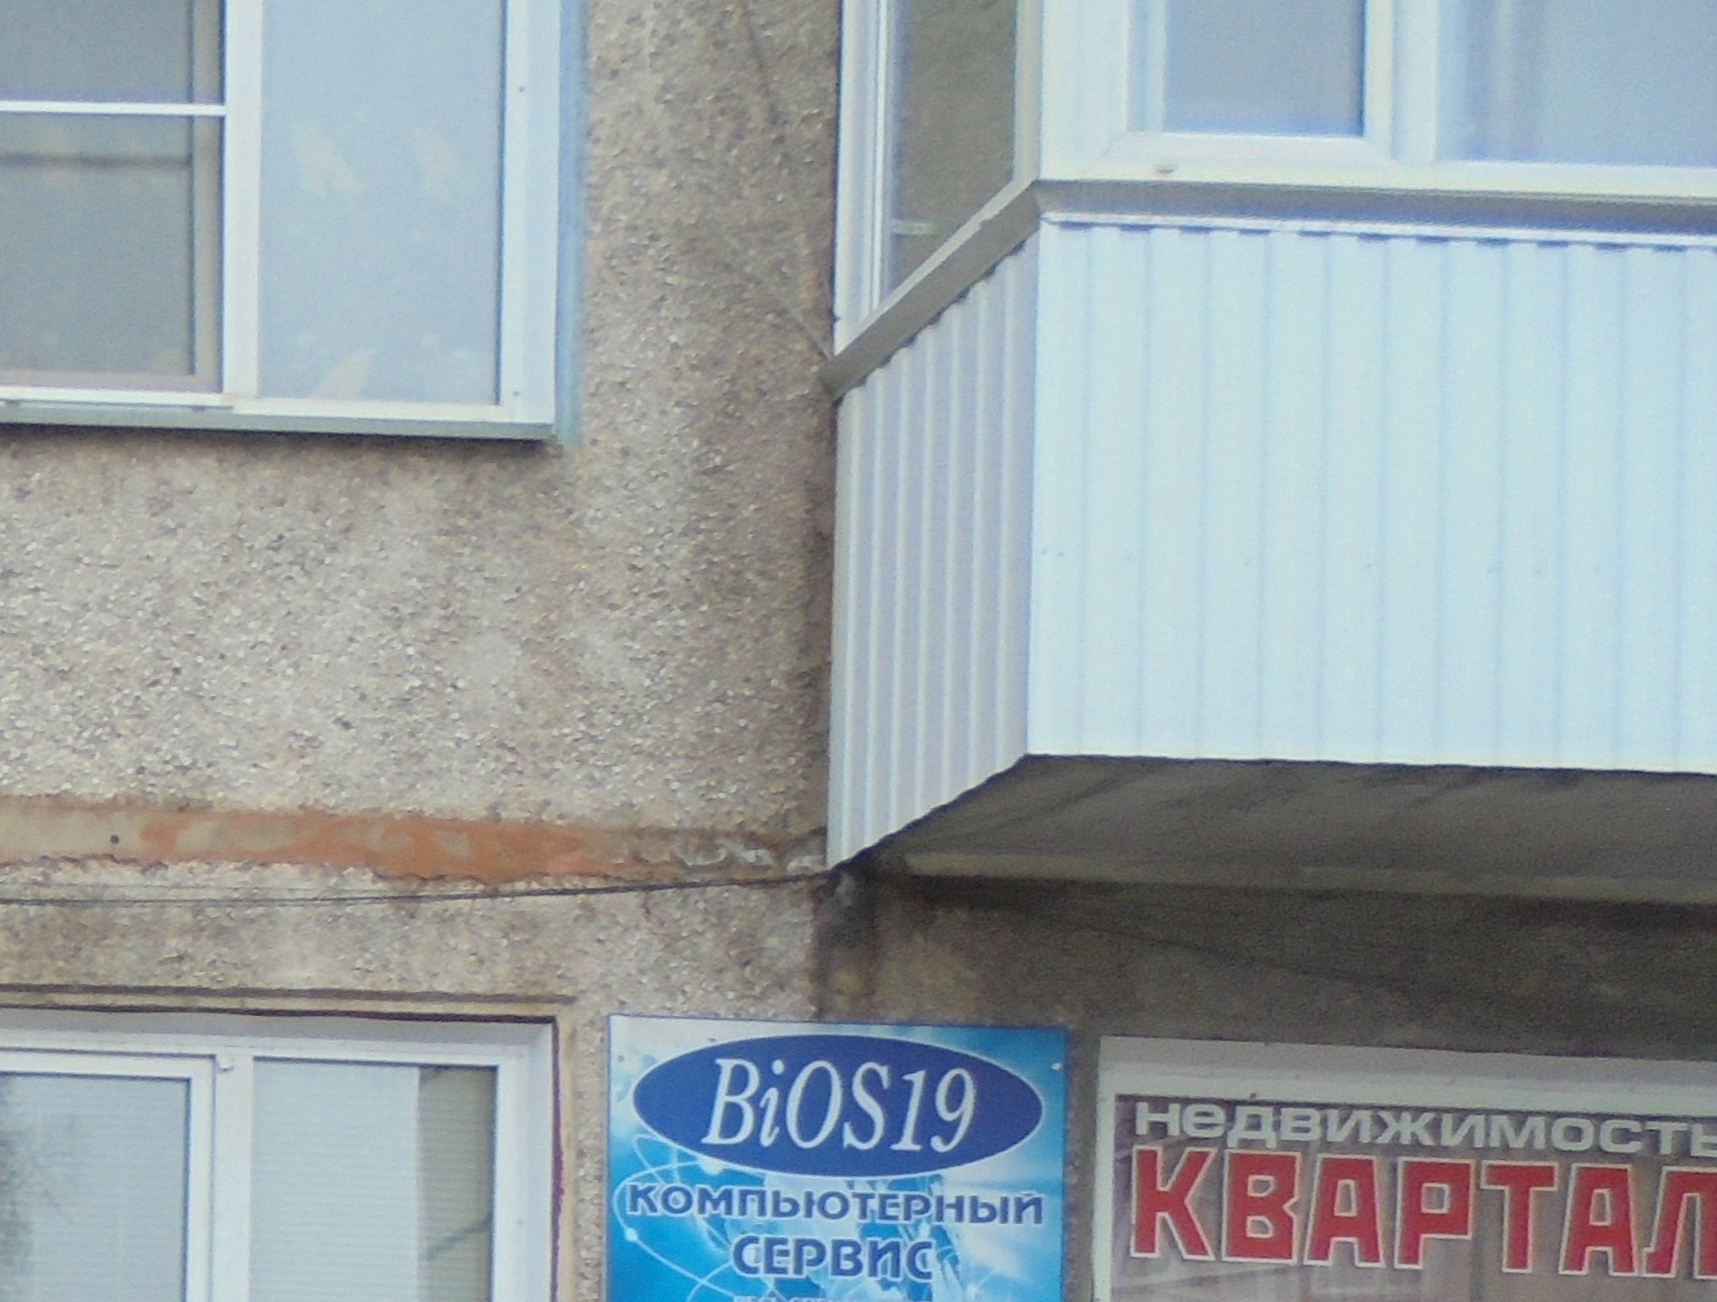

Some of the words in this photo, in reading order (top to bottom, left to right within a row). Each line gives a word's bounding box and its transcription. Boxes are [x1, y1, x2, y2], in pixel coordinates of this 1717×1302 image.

[701, 1057, 977, 1153] BiOS19
[627, 1184, 1043, 1225] КОМПЬЮТЕРНЫЙ
[1130, 1146, 1717, 1280] КВАРТАЛ
[733, 1237, 934, 1280] СЕРВИС
